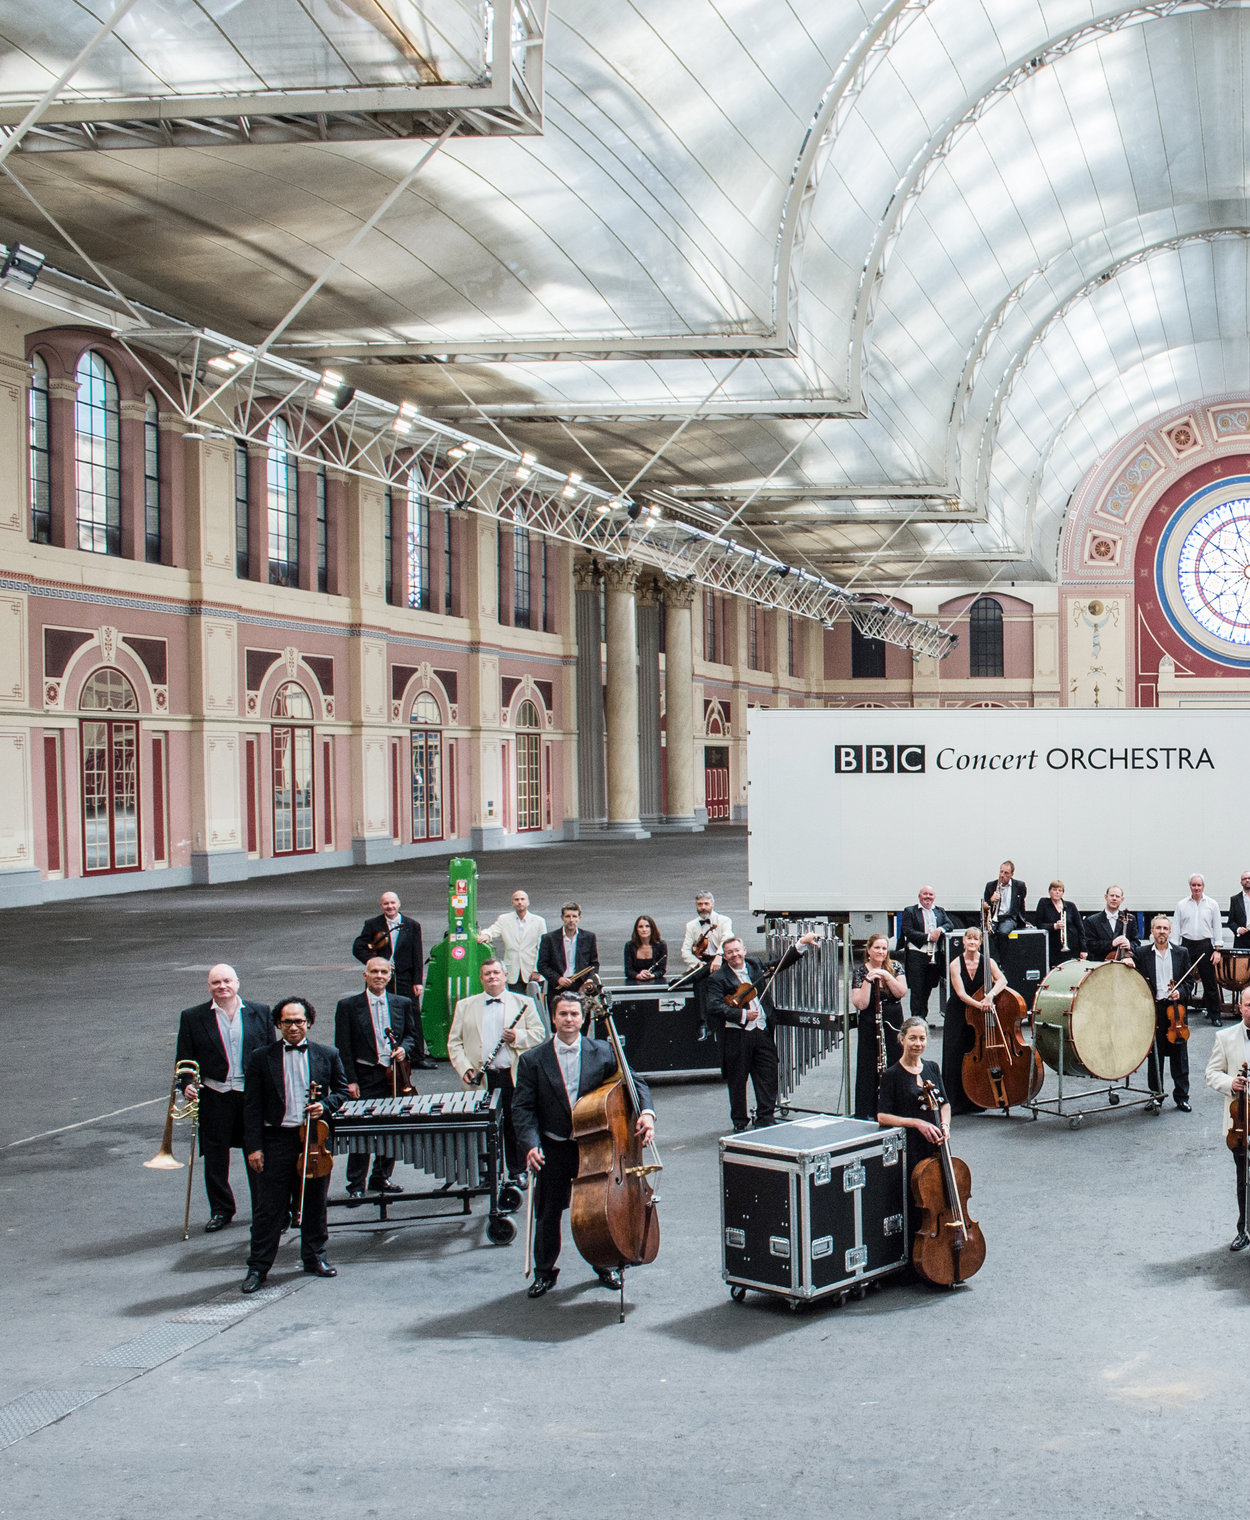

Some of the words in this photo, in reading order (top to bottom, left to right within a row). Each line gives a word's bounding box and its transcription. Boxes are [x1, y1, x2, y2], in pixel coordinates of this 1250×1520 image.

[835, 745, 925, 773] BBC
[936, 747, 1038, 770] Concert
[1046, 747, 1215, 770] ORCHESTRA
